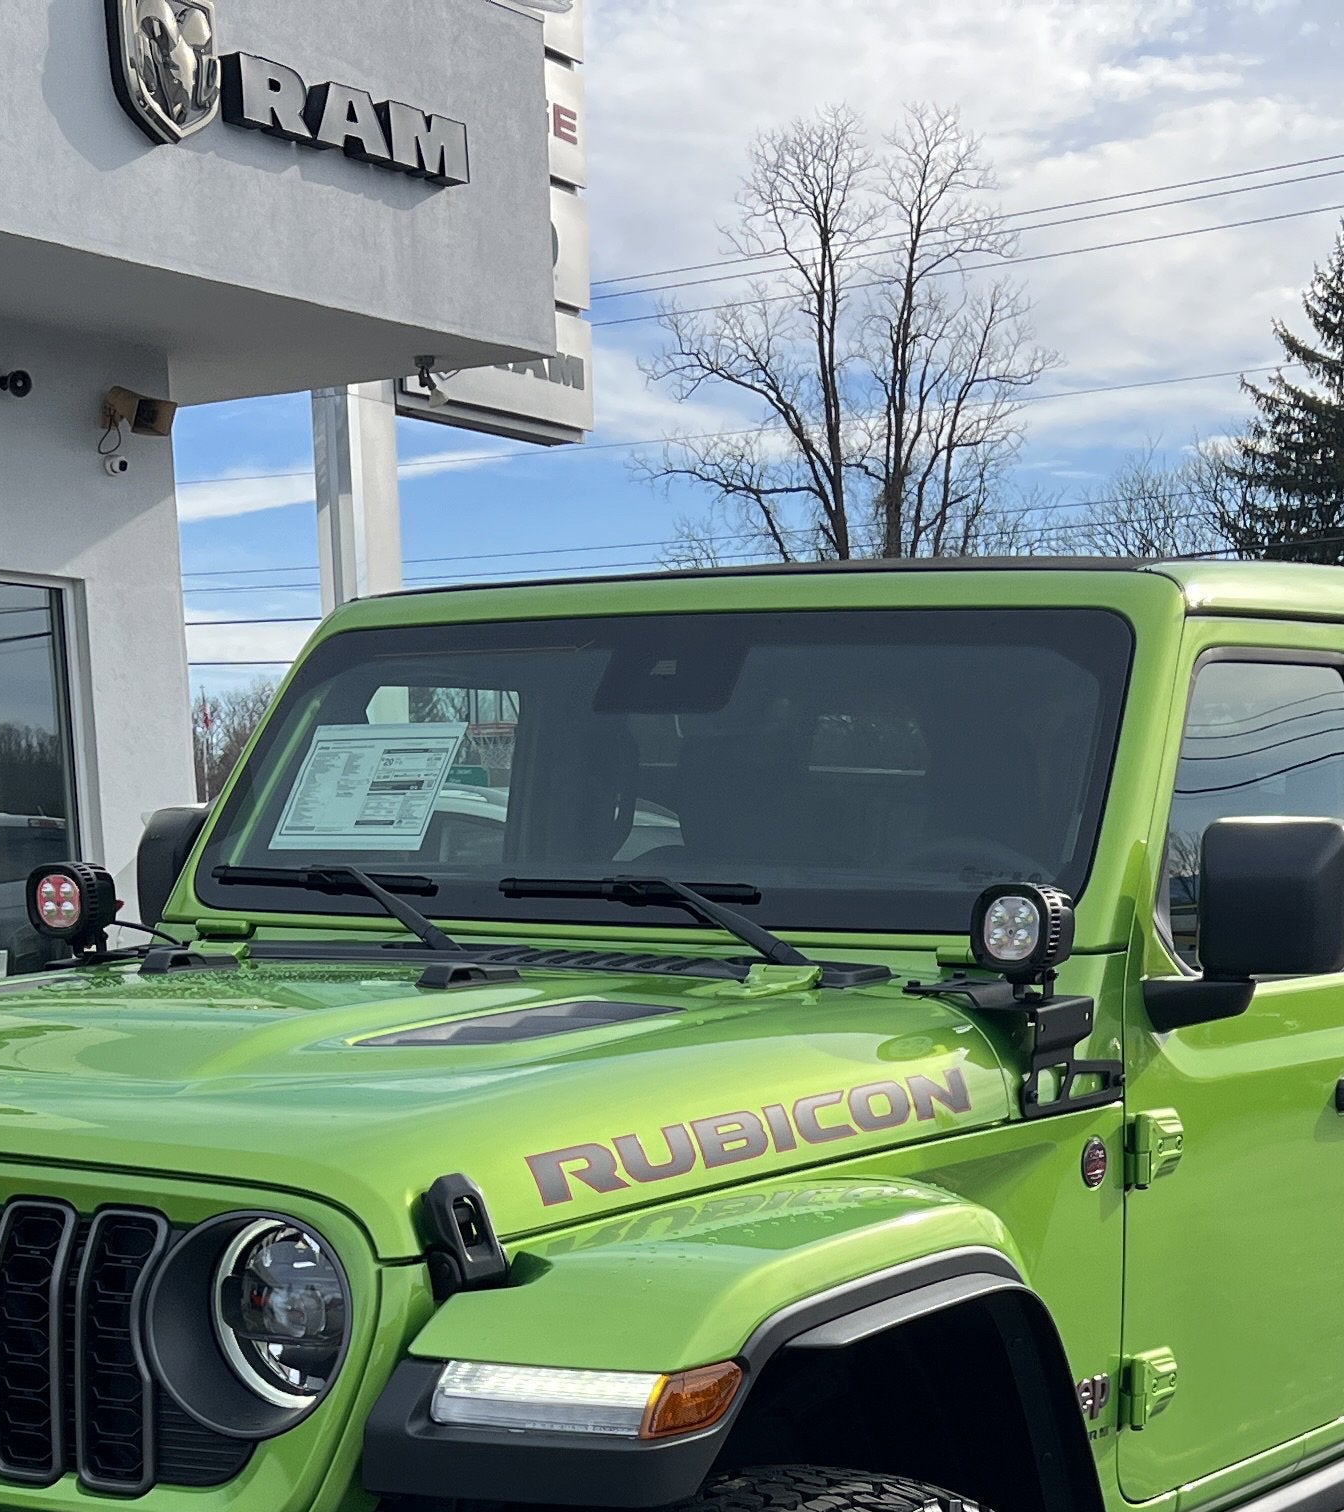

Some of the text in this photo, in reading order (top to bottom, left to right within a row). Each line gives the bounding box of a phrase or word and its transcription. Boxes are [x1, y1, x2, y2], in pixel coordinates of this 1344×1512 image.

[233, 50, 471, 186] RAM
[494, 352, 585, 391] AM
[524, 1068, 972, 1207] RUBICON
[1076, 1372, 1111, 1421] ep
